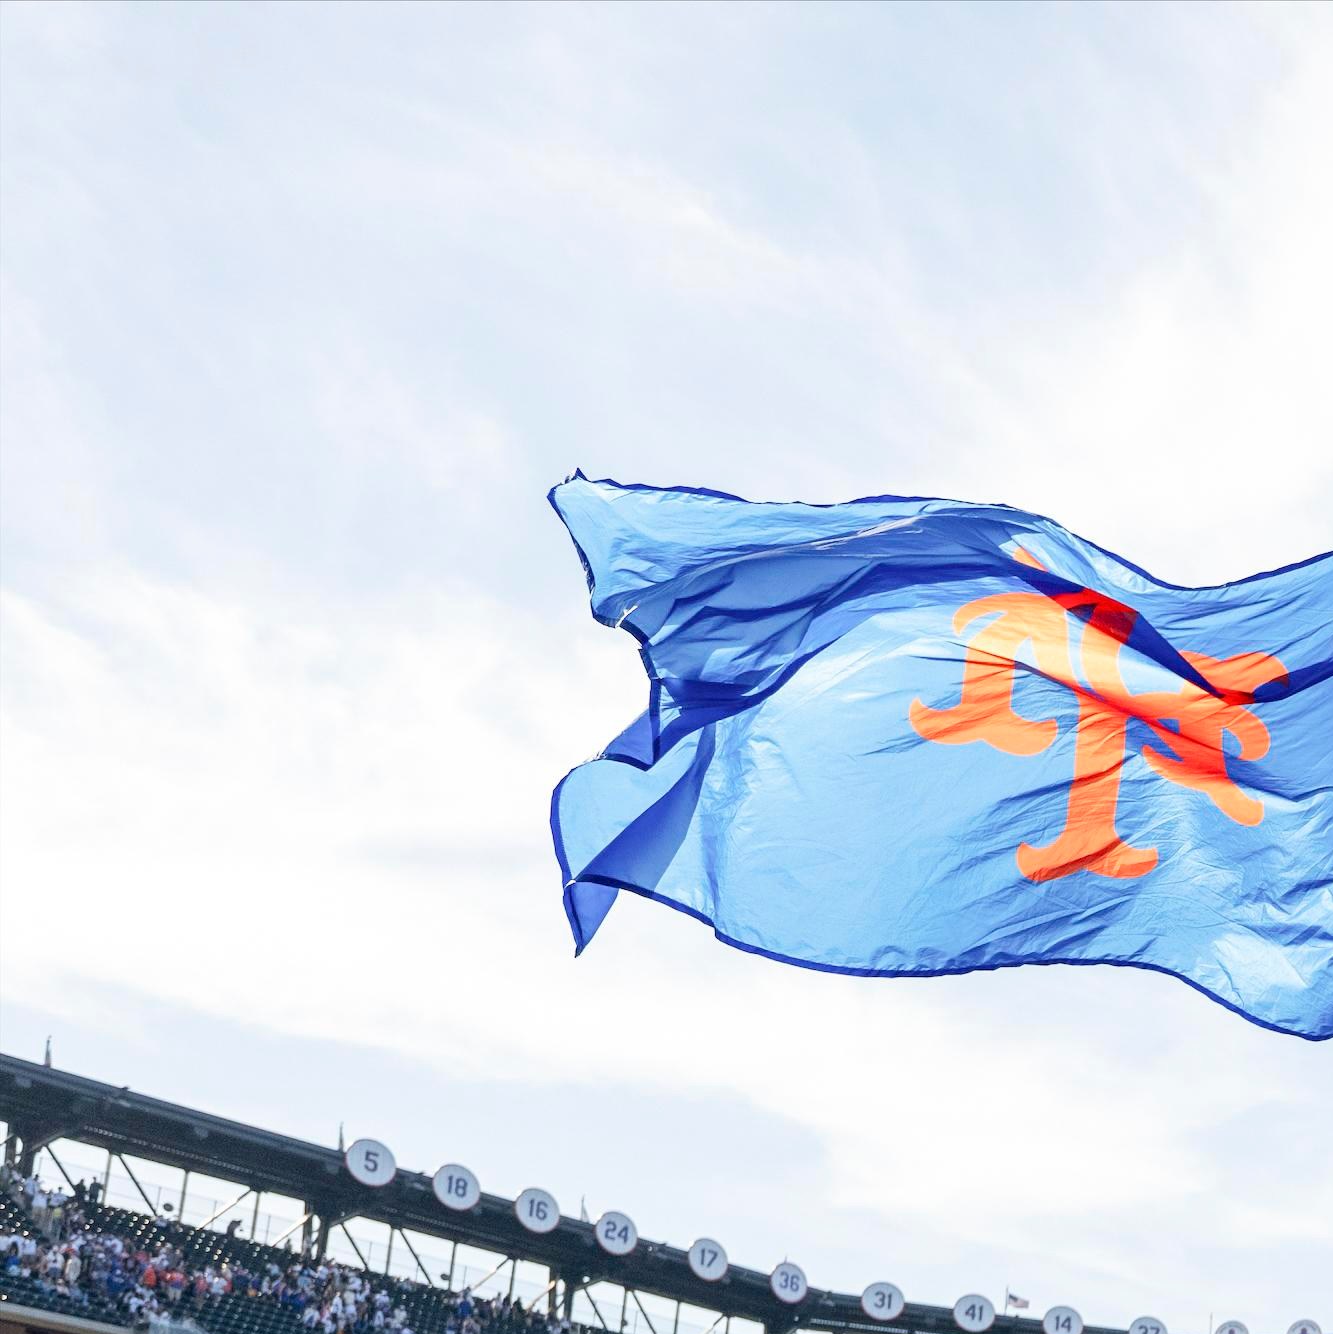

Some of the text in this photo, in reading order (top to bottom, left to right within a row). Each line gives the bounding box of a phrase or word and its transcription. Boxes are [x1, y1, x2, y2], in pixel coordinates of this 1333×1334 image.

[364, 1151, 379, 1173] 5
[447, 1175, 468, 1198] 18
[529, 1198, 549, 1221] 16
[605, 1221, 629, 1244] 24
[700, 1248, 718, 1268] 17
[779, 1271, 800, 1292] 36
[874, 1291, 893, 1310] 31
[965, 1304, 983, 1316] 41
[1055, 1315, 1072, 1332] 14
